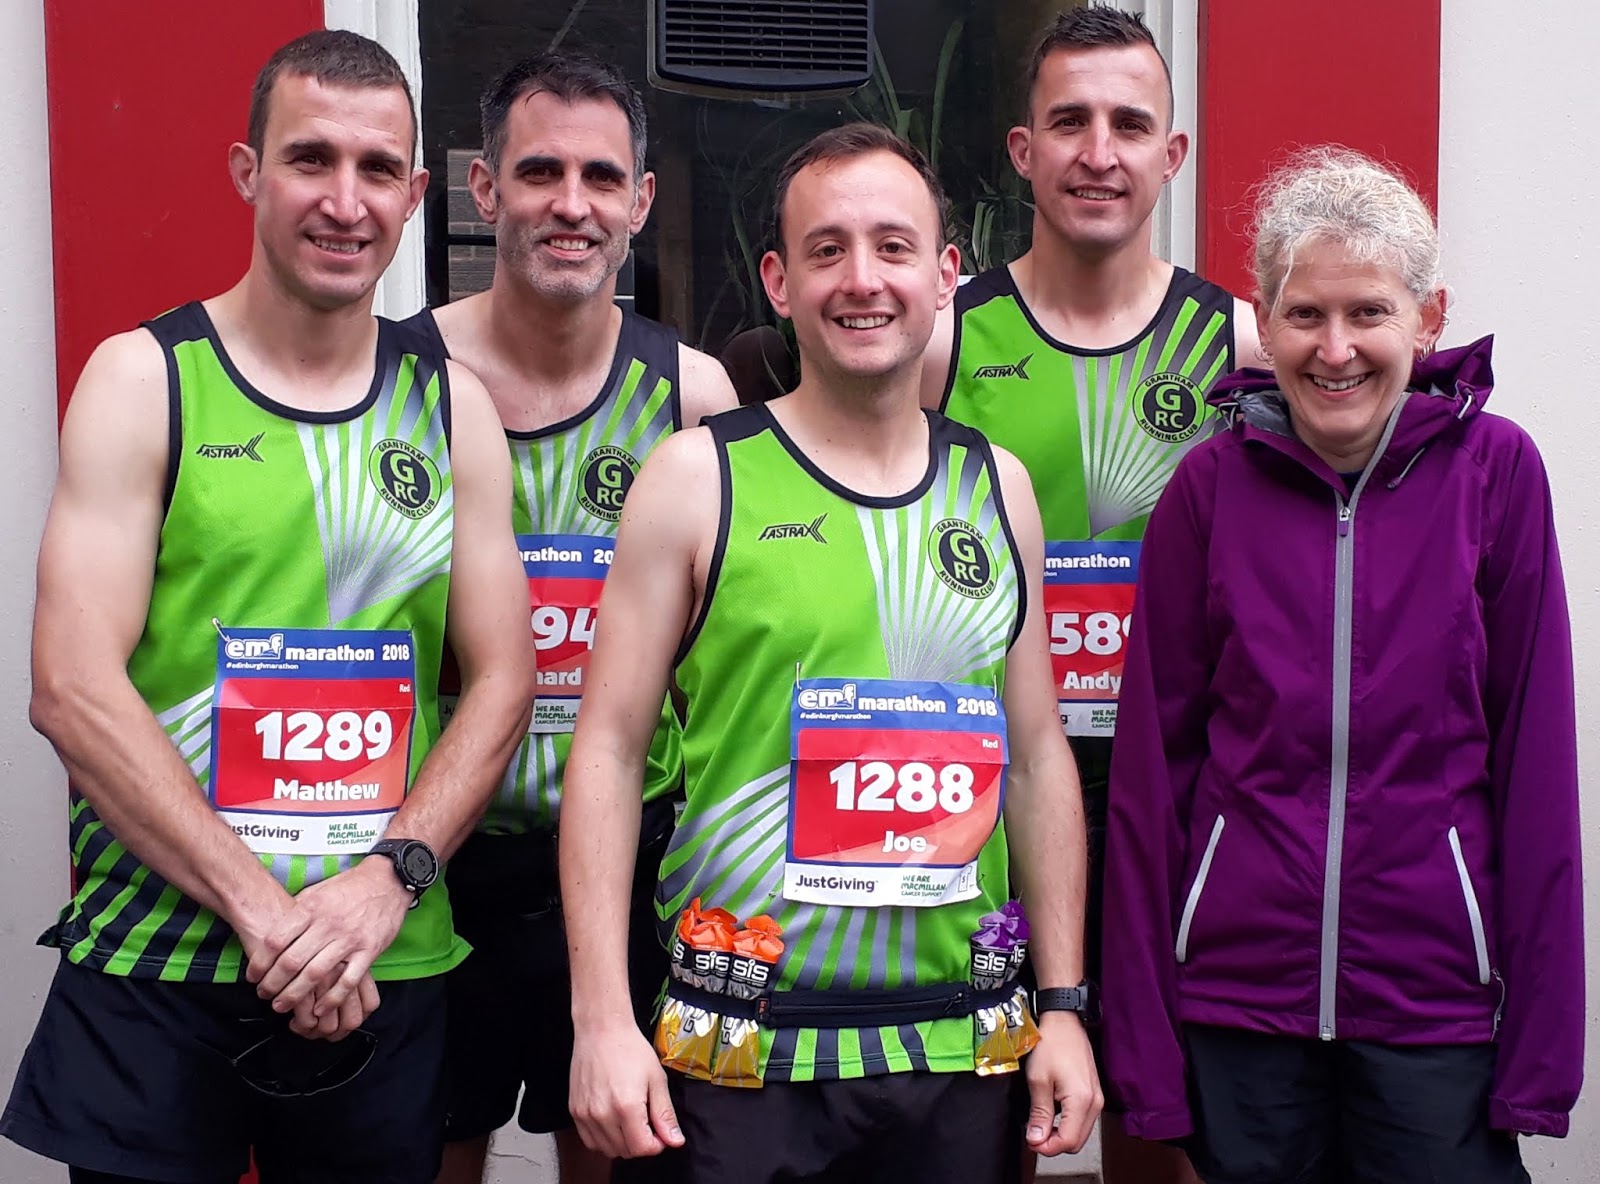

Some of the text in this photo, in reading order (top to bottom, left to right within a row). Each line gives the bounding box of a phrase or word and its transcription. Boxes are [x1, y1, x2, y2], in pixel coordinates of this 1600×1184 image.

[1145, 374, 1194, 390] GRANTHAM
[1155, 383, 1181, 411] G
[1140, 418, 1198, 441] RUNNING CLUB
[1155, 410, 1184, 429] RC
[378, 441, 425, 463] GRANTHAM
[588, 447, 635, 467] GRANTHAM
[390, 452, 415, 484] G
[597, 458, 622, 488] G
[380, 488, 435, 517] RUNNING CLUB
[393, 480, 420, 505] RC
[596, 487, 624, 507] RC
[581, 496, 618, 520] RUNNING
[937, 520, 984, 541] GRANTHAM
[593, 548, 614, 565] 20
[950, 531, 977, 563] G
[953, 560, 983, 584] RC
[1045, 553, 1131, 569] marathon
[939, 570, 994, 597] RUNNING CLUB
[227, 634, 410, 661] emf marathon 2018
[226, 661, 299, 671] #edinburghmarathon
[399, 683, 411, 693] Red
[1063, 671, 1122, 694] Andy
[799, 684, 998, 716] emf marathon 2018
[800, 712, 871, 721] #edinburghmarathon
[254, 710, 393, 761] 1289
[982, 738, 998, 748] Red
[273, 778, 380, 801] Matthew
[829, 761, 974, 813] 1288
[329, 823, 341, 831] WE
[881, 830, 927, 853] Joe
[795, 874, 876, 893] JustGiving
